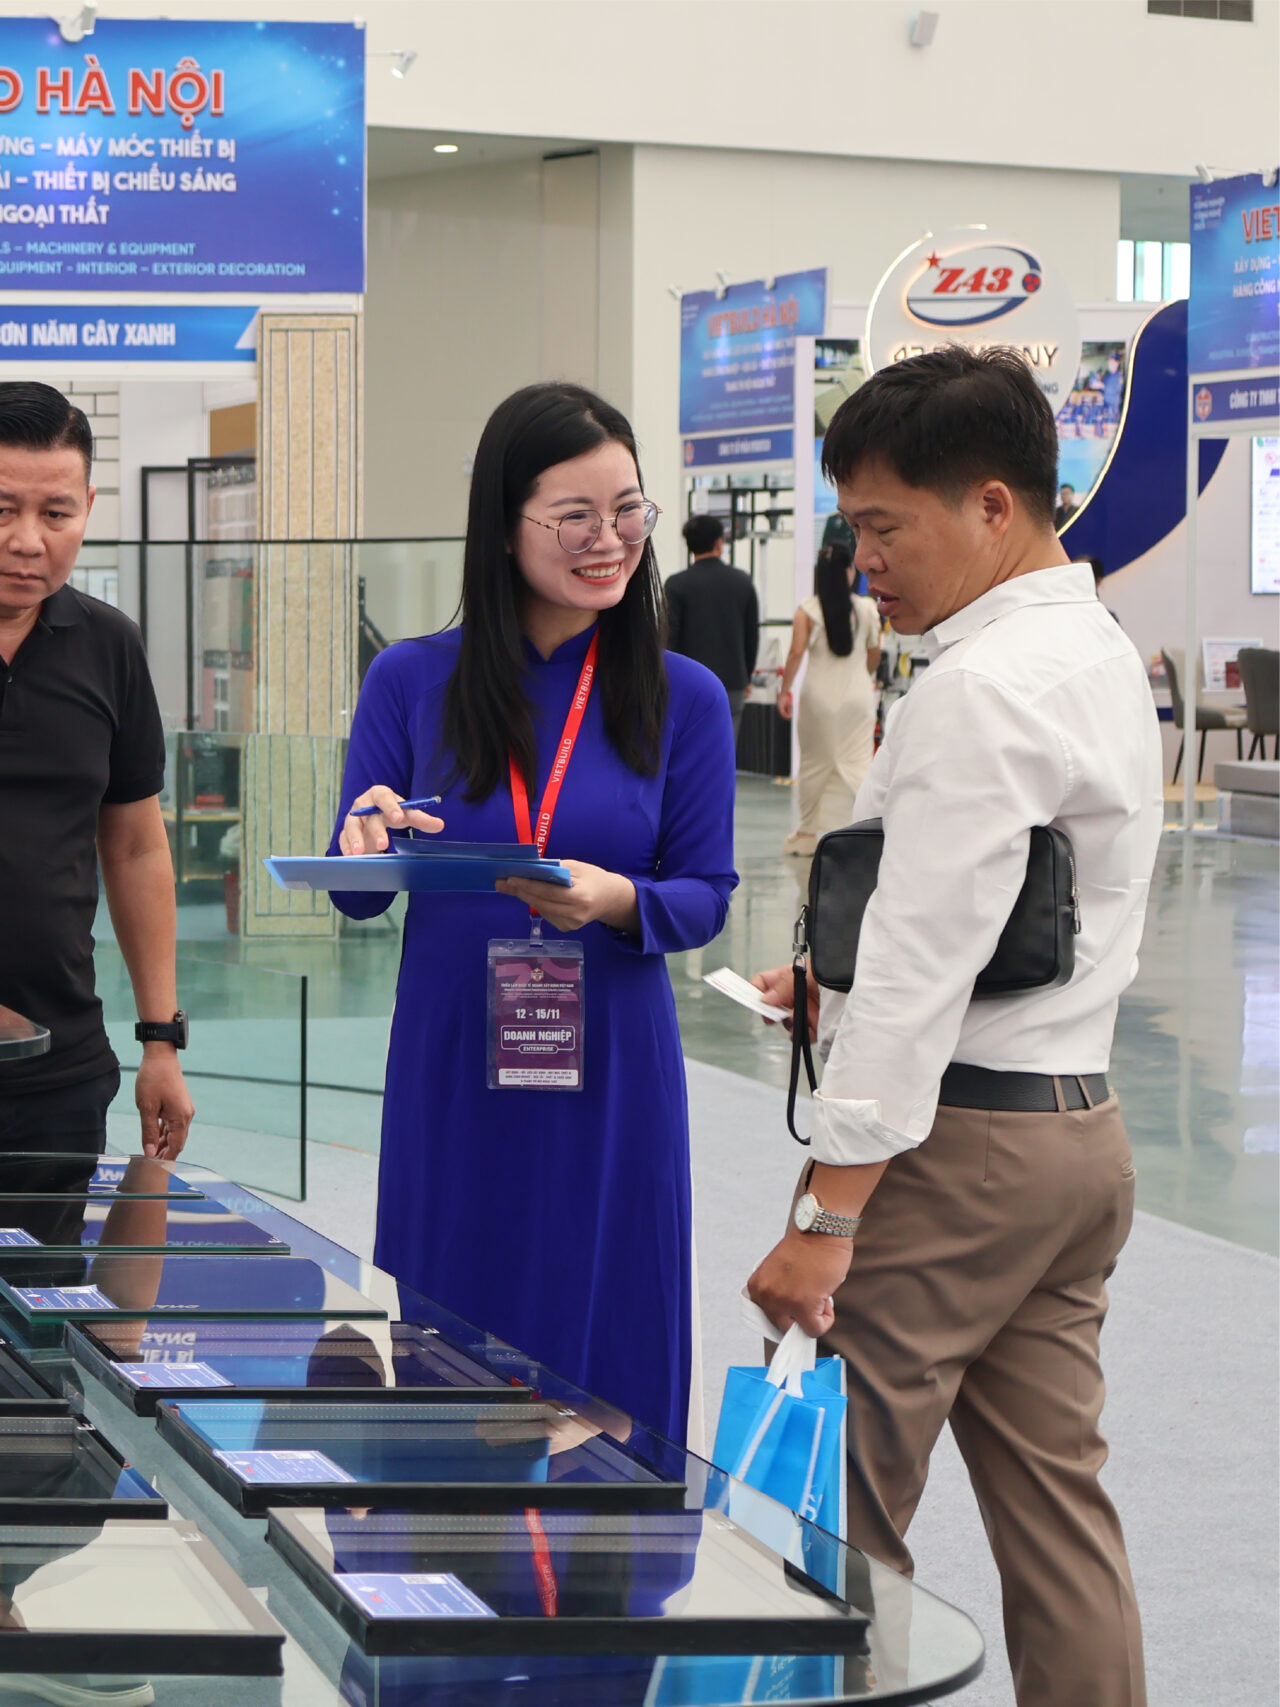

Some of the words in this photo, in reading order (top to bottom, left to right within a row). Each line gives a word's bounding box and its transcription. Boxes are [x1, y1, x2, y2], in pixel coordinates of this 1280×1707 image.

[36, 54, 115, 116] HÀ
[127, 57, 224, 131] NỘI
[56, 132, 103, 156] MÁY
[108, 132, 155, 157] MÓC
[158, 129, 213, 158] THIẾT
[217, 138, 236, 163] BỊ
[33, 162, 87, 191] THIẾT
[92, 171, 110, 195] BỊ
[114, 162, 175, 191] CHIẾU
[180, 166, 236, 192] SÁNG
[60, 196, 109, 225] THẤT
[26, 241, 103, 255] MACHINERY
[107, 242, 117, 255] &
[121, 243, 195, 256] EQUIPMENT
[76, 261, 137, 275] INTERIOR
[152, 262, 215, 276] EXTERIOR
[220, 263, 305, 276] DECORATION
[932, 266, 1013, 294] Z43
[32, 319, 77, 346] NĂM
[82, 319, 120, 346] CÂY
[124, 322, 176, 346] XANH
[574, 664, 593, 711] VIETBUILD
[551, 738, 572, 783] VIETBUILD
[537, 812, 551, 857] ETBUILD
[515, 1008, 526, 1019] 12
[535, 1008, 561, 1019] 15/11
[504, 1031, 536, 1041] DOANH
[538, 1029, 572, 1043] NGHIỆP
